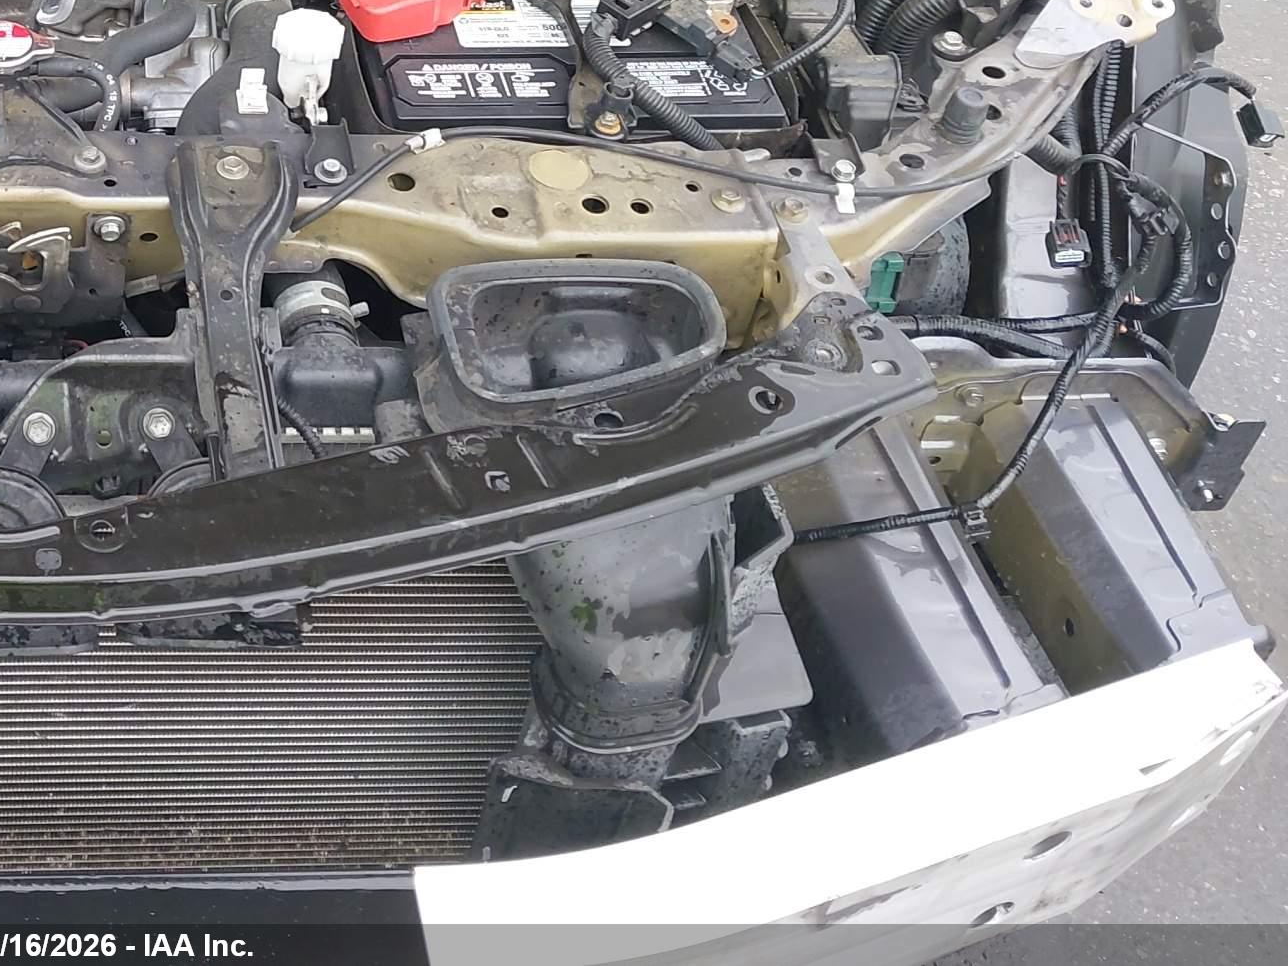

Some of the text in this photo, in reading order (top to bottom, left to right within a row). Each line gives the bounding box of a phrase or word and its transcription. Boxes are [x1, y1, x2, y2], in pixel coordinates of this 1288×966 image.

[433, 63, 479, 72] DANGER
[489, 62, 532, 71] POISON
[103, 104, 116, 122] TPC
